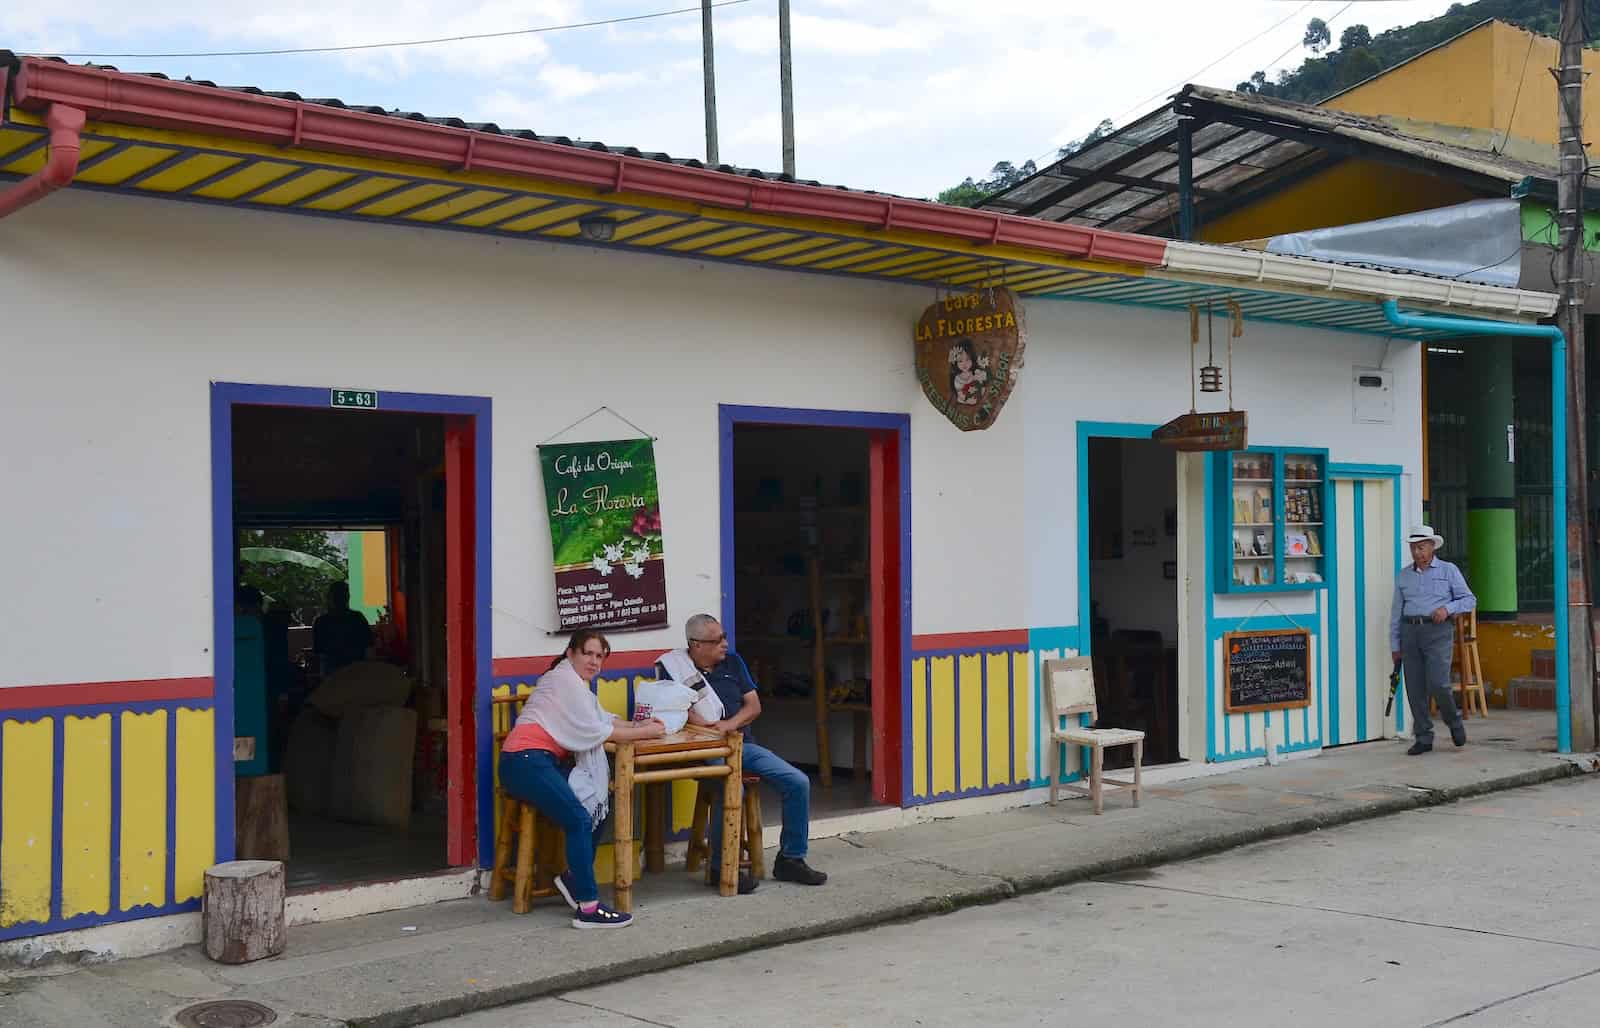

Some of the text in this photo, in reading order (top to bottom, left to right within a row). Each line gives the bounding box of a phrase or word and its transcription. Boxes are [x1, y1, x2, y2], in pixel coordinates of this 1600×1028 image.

[915, 311, 1017, 341] LA FLORESTA
[555, 454, 582, 478] Café
[583, 456, 595, 472] de
[551, 484, 646, 517] La Floresta
